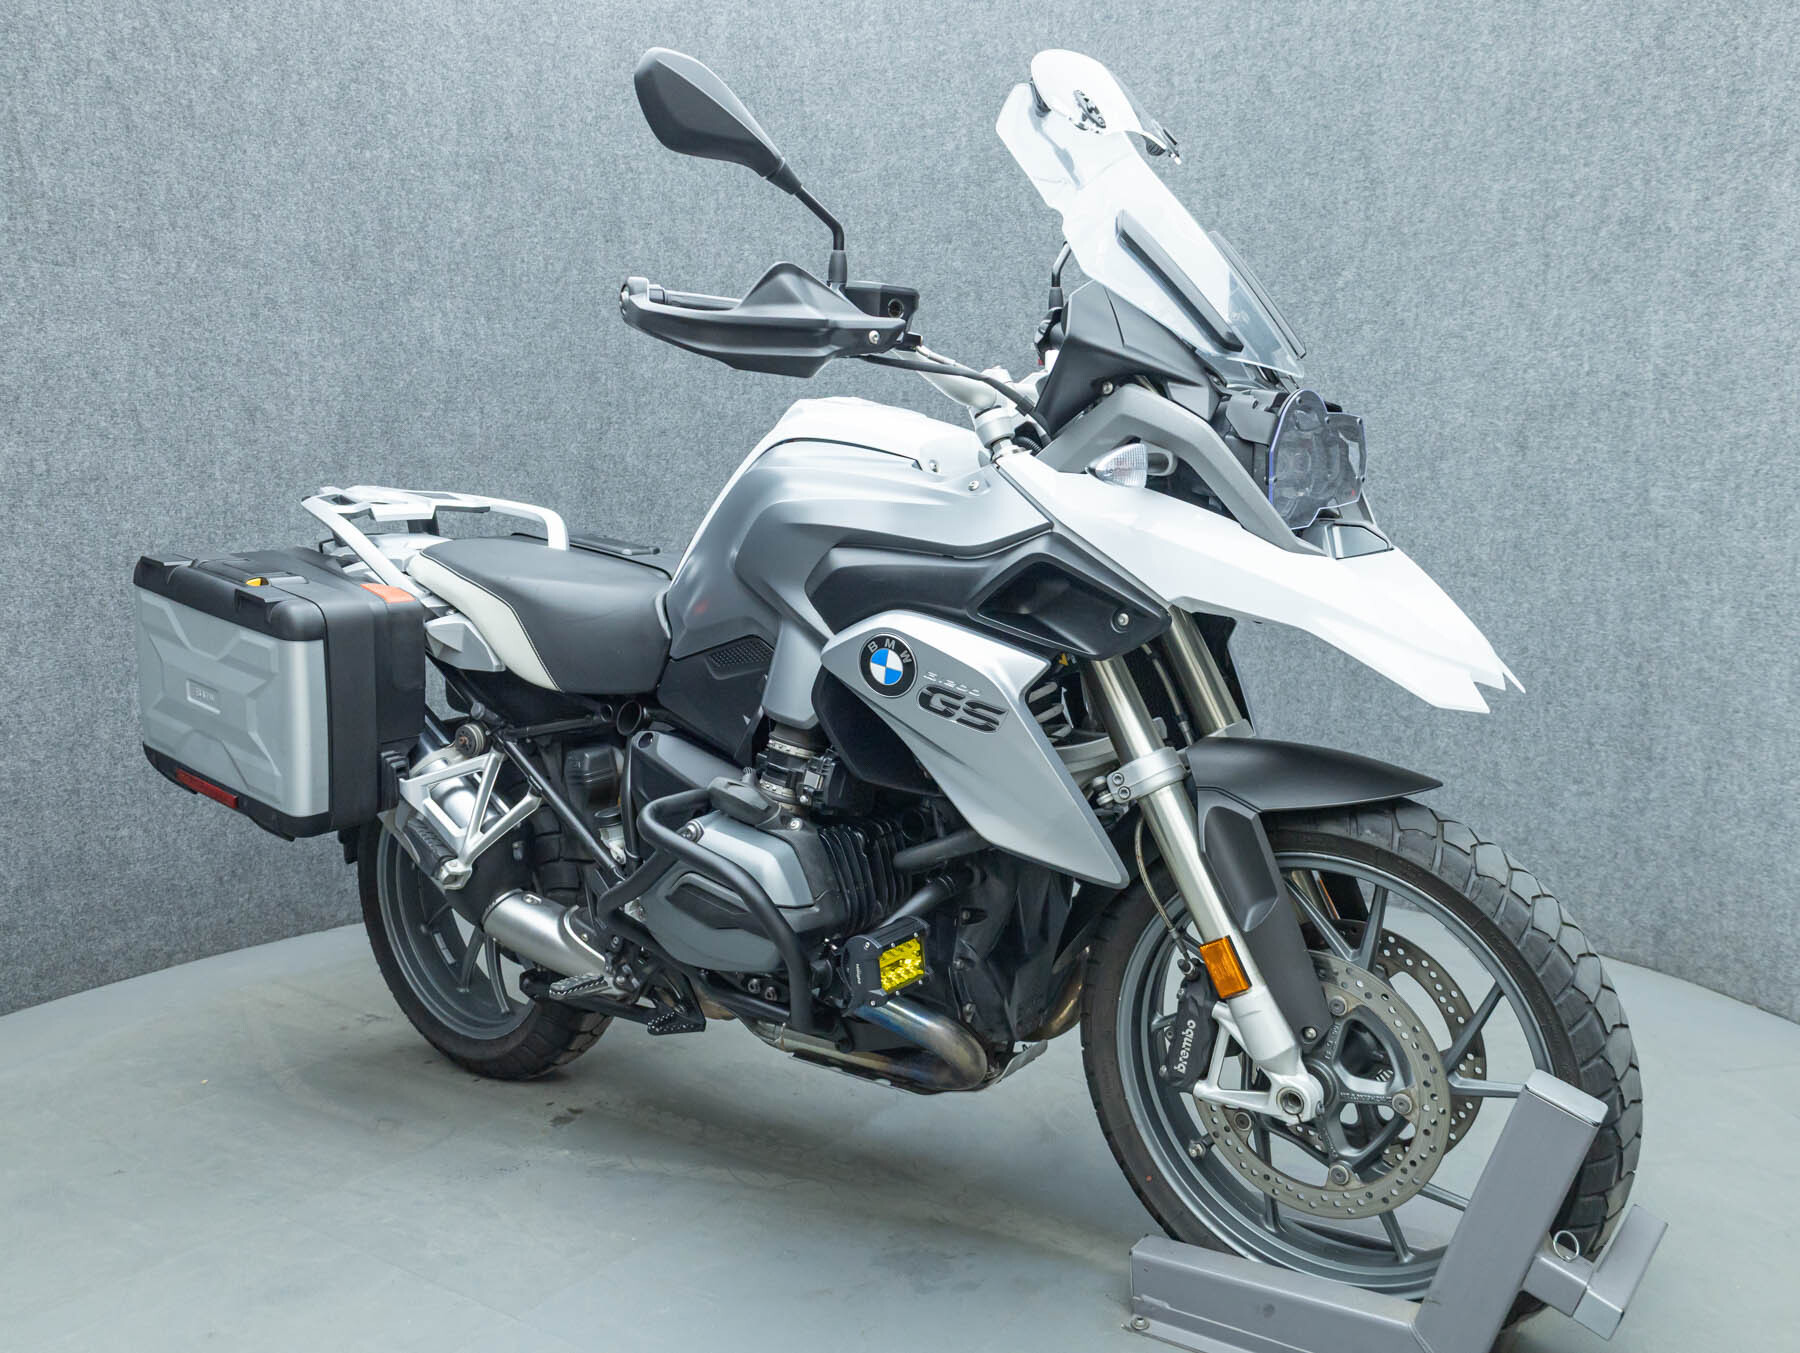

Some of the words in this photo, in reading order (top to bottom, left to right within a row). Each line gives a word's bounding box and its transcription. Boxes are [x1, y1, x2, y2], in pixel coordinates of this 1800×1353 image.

[867, 638, 912, 664] BMW
[917, 684, 1008, 733] GS
[1173, 1019, 1196, 1074] brembo
